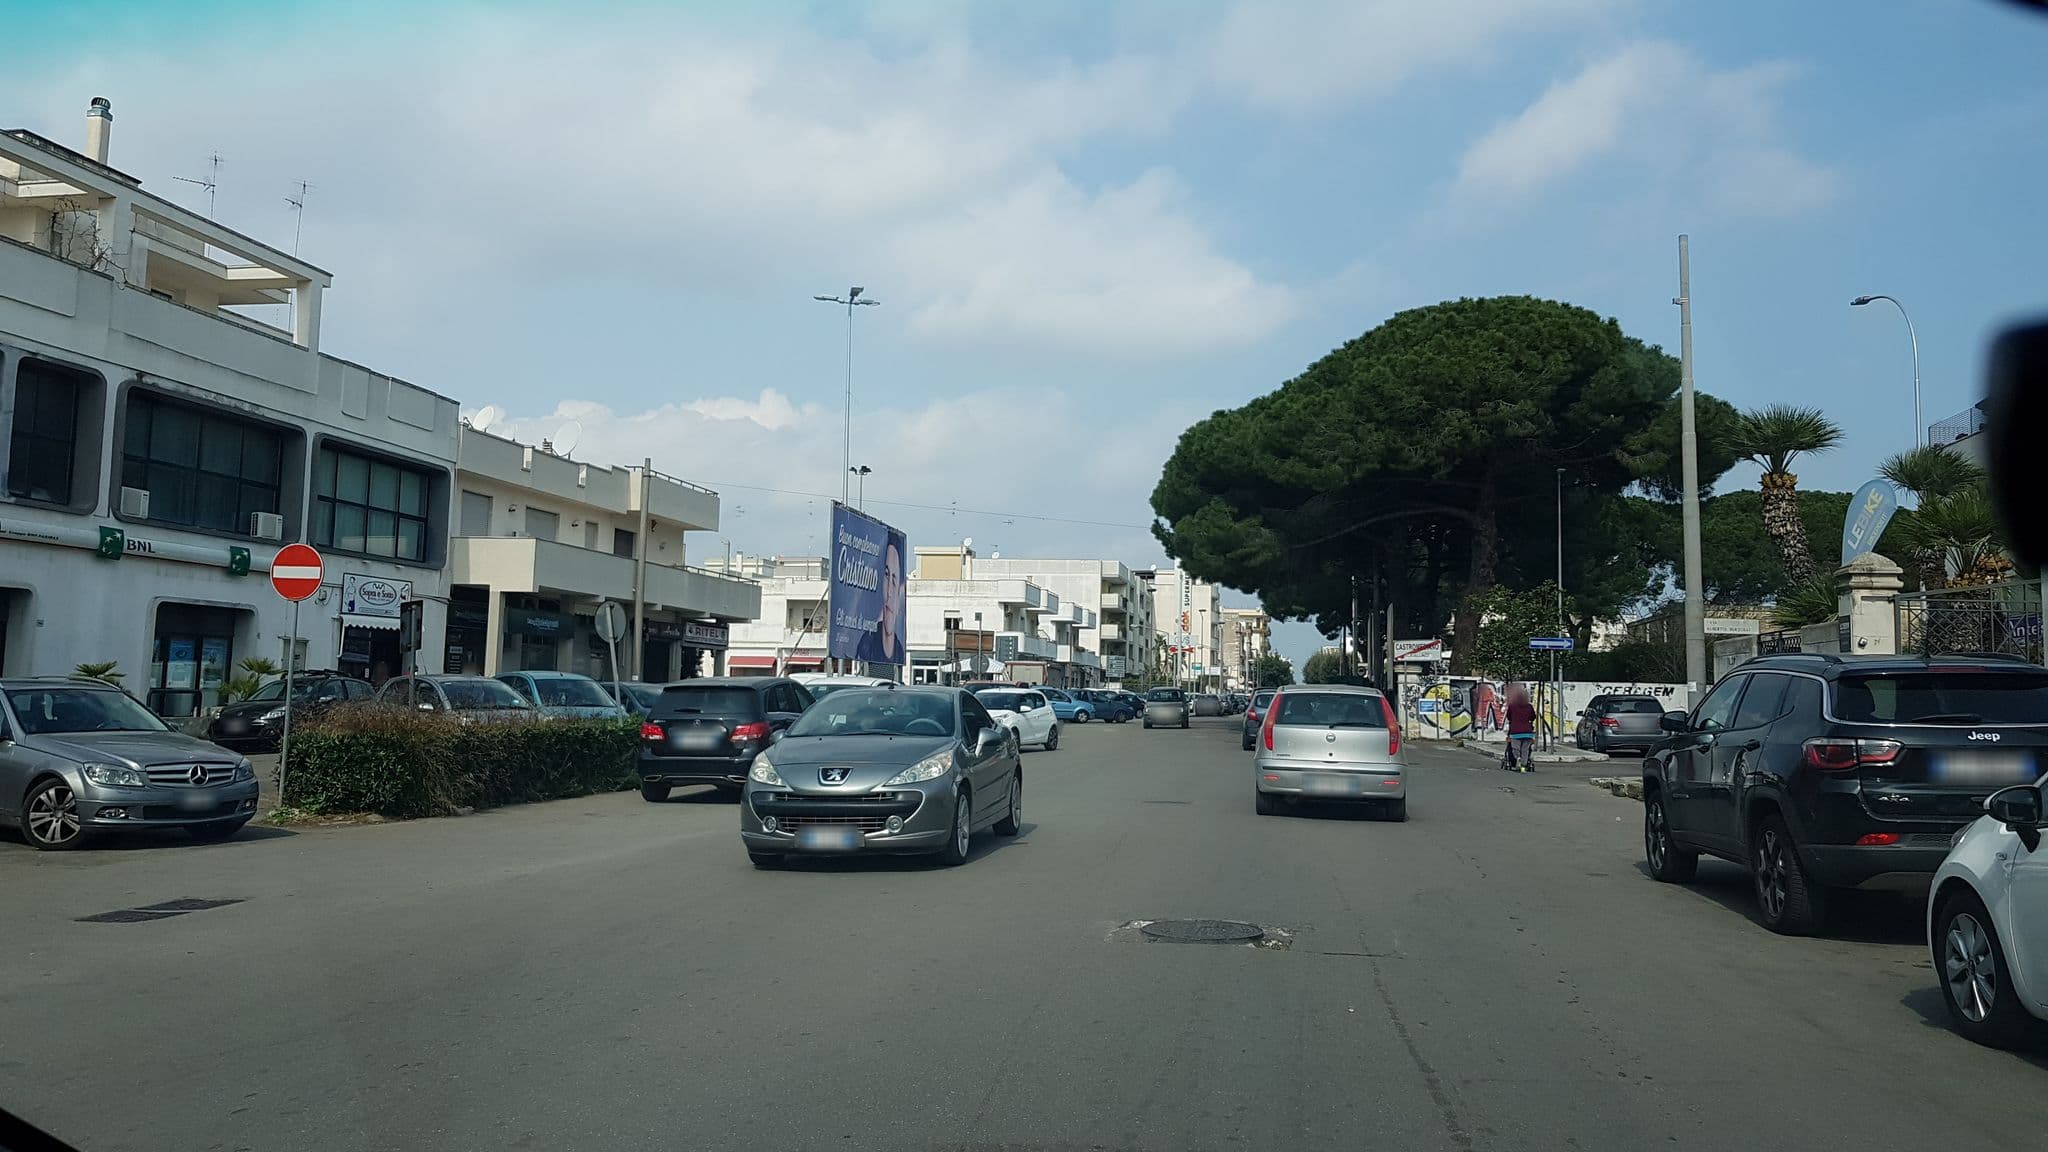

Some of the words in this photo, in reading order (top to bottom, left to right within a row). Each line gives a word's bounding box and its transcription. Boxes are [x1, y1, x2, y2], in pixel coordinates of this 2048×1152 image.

[1847, 487, 1884, 550] LEBIKE
[126, 538, 156, 554] BNL
[838, 545, 879, 592] Cristiano
[695, 626, 720, 638] RITEL
[1967, 731, 2001, 742] Jeep
